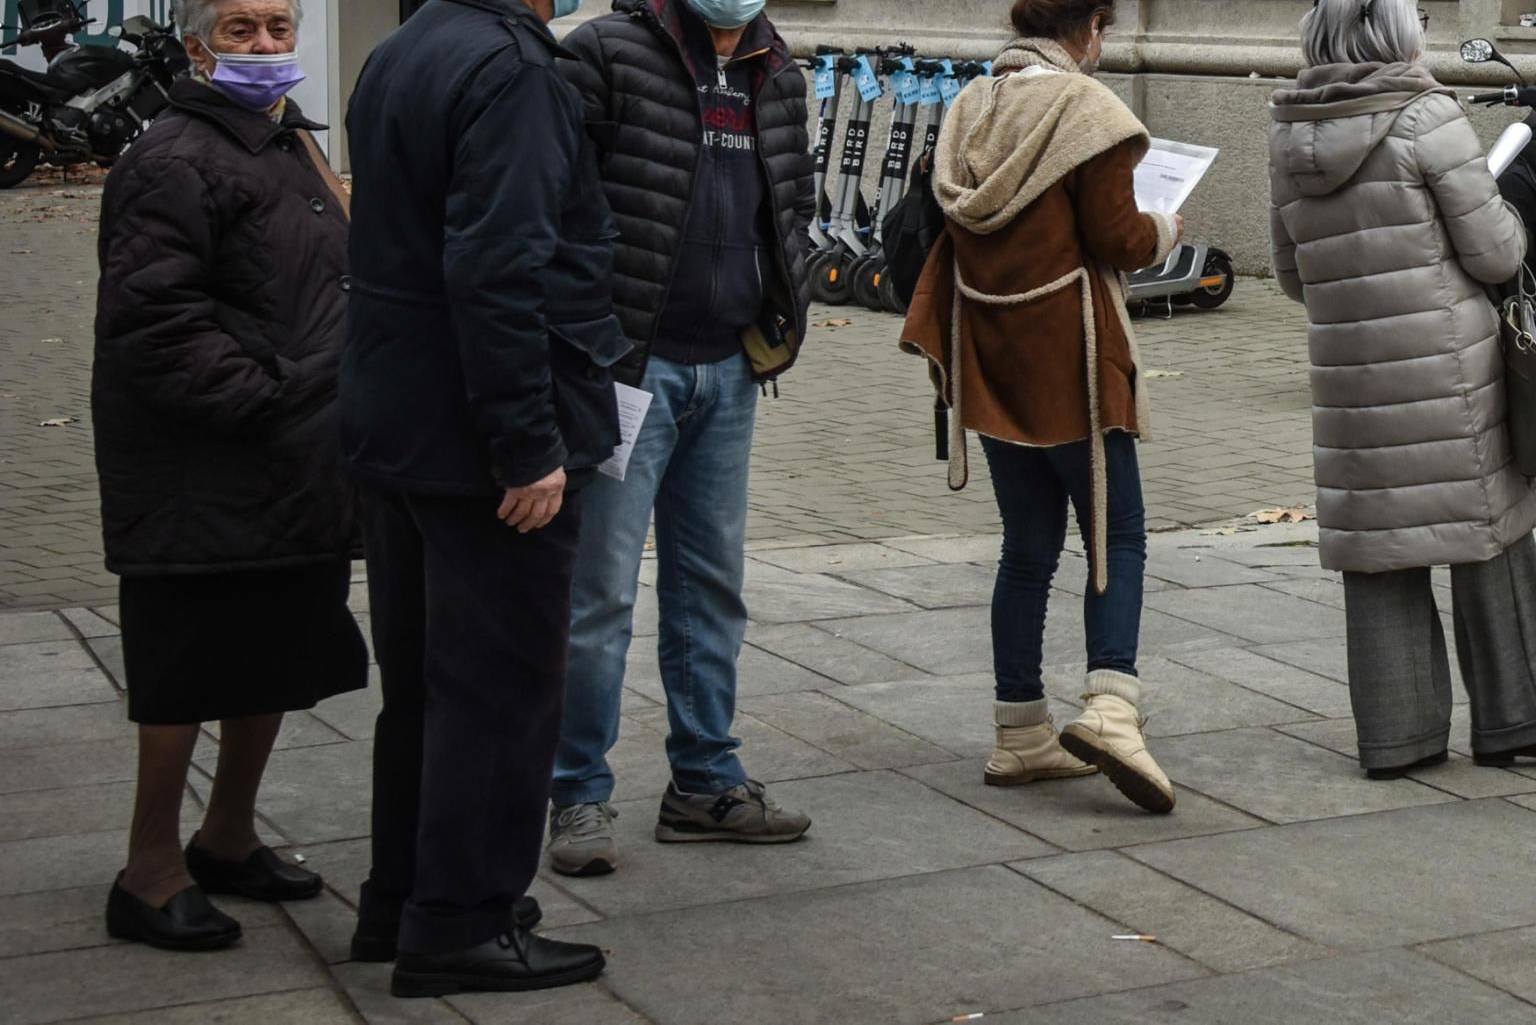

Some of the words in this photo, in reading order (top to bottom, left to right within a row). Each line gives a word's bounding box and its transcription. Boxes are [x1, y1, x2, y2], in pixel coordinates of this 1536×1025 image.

[816, 126, 829, 164] BIRD
[842, 128, 856, 165] BIRD
[852, 129, 865, 167] BIRD
[887, 130, 900, 168] BIRD
[894, 131, 907, 169] BIRD
